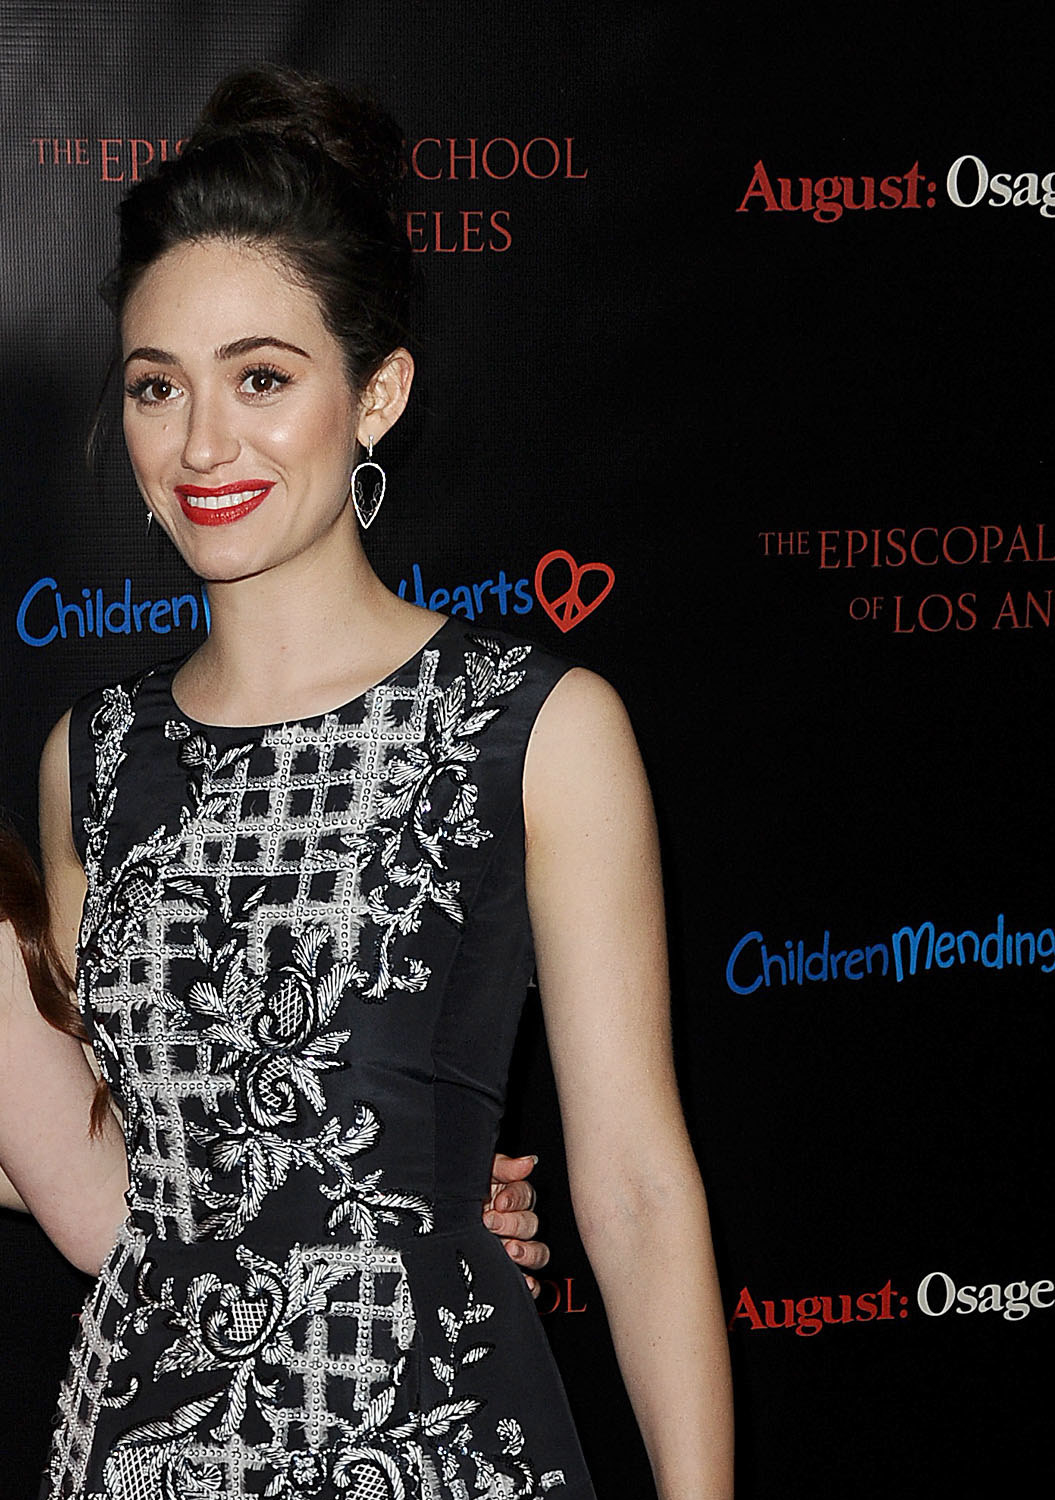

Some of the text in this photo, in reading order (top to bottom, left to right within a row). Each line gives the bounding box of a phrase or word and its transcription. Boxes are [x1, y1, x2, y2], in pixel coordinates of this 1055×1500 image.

[31, 137, 91, 165] THE
[404, 136, 590, 181] CHOOL
[735, 159, 937, 224] August:
[405, 208, 513, 254] ELES
[758, 522, 1055, 570] THE EPISCOPAL
[16, 576, 198, 648] Children
[848, 596, 886, 621] OF
[892, 592, 978, 634] LOS
[725, 930, 890, 996] Children
[728, 1271, 1055, 1337] August: Osage
